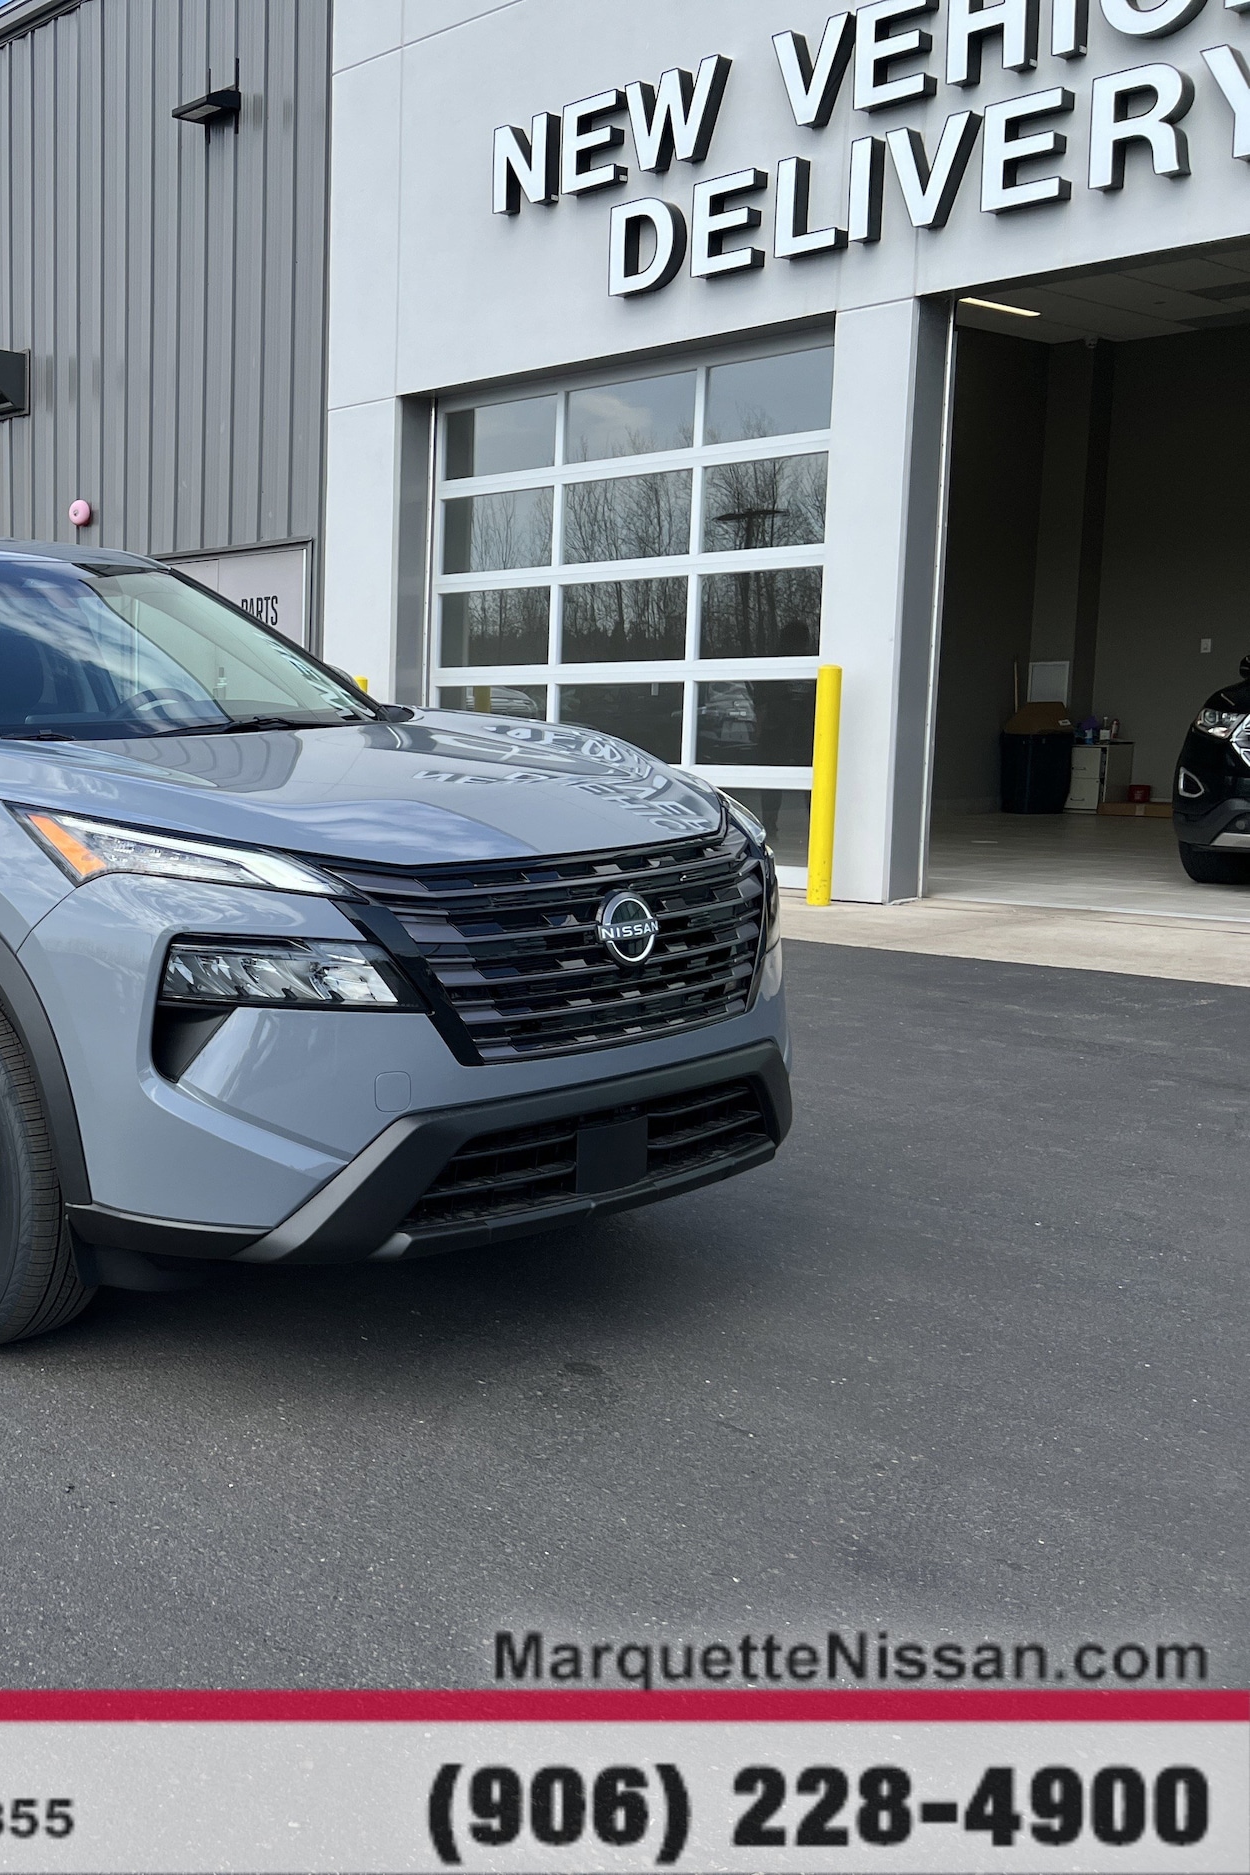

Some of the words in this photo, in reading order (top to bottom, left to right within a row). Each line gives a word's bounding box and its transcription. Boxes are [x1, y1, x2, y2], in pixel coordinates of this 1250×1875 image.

[492, 54, 731, 216] NEW
[771, 0, 1250, 128] VEHI
[601, 920, 659, 939] NISSAN
